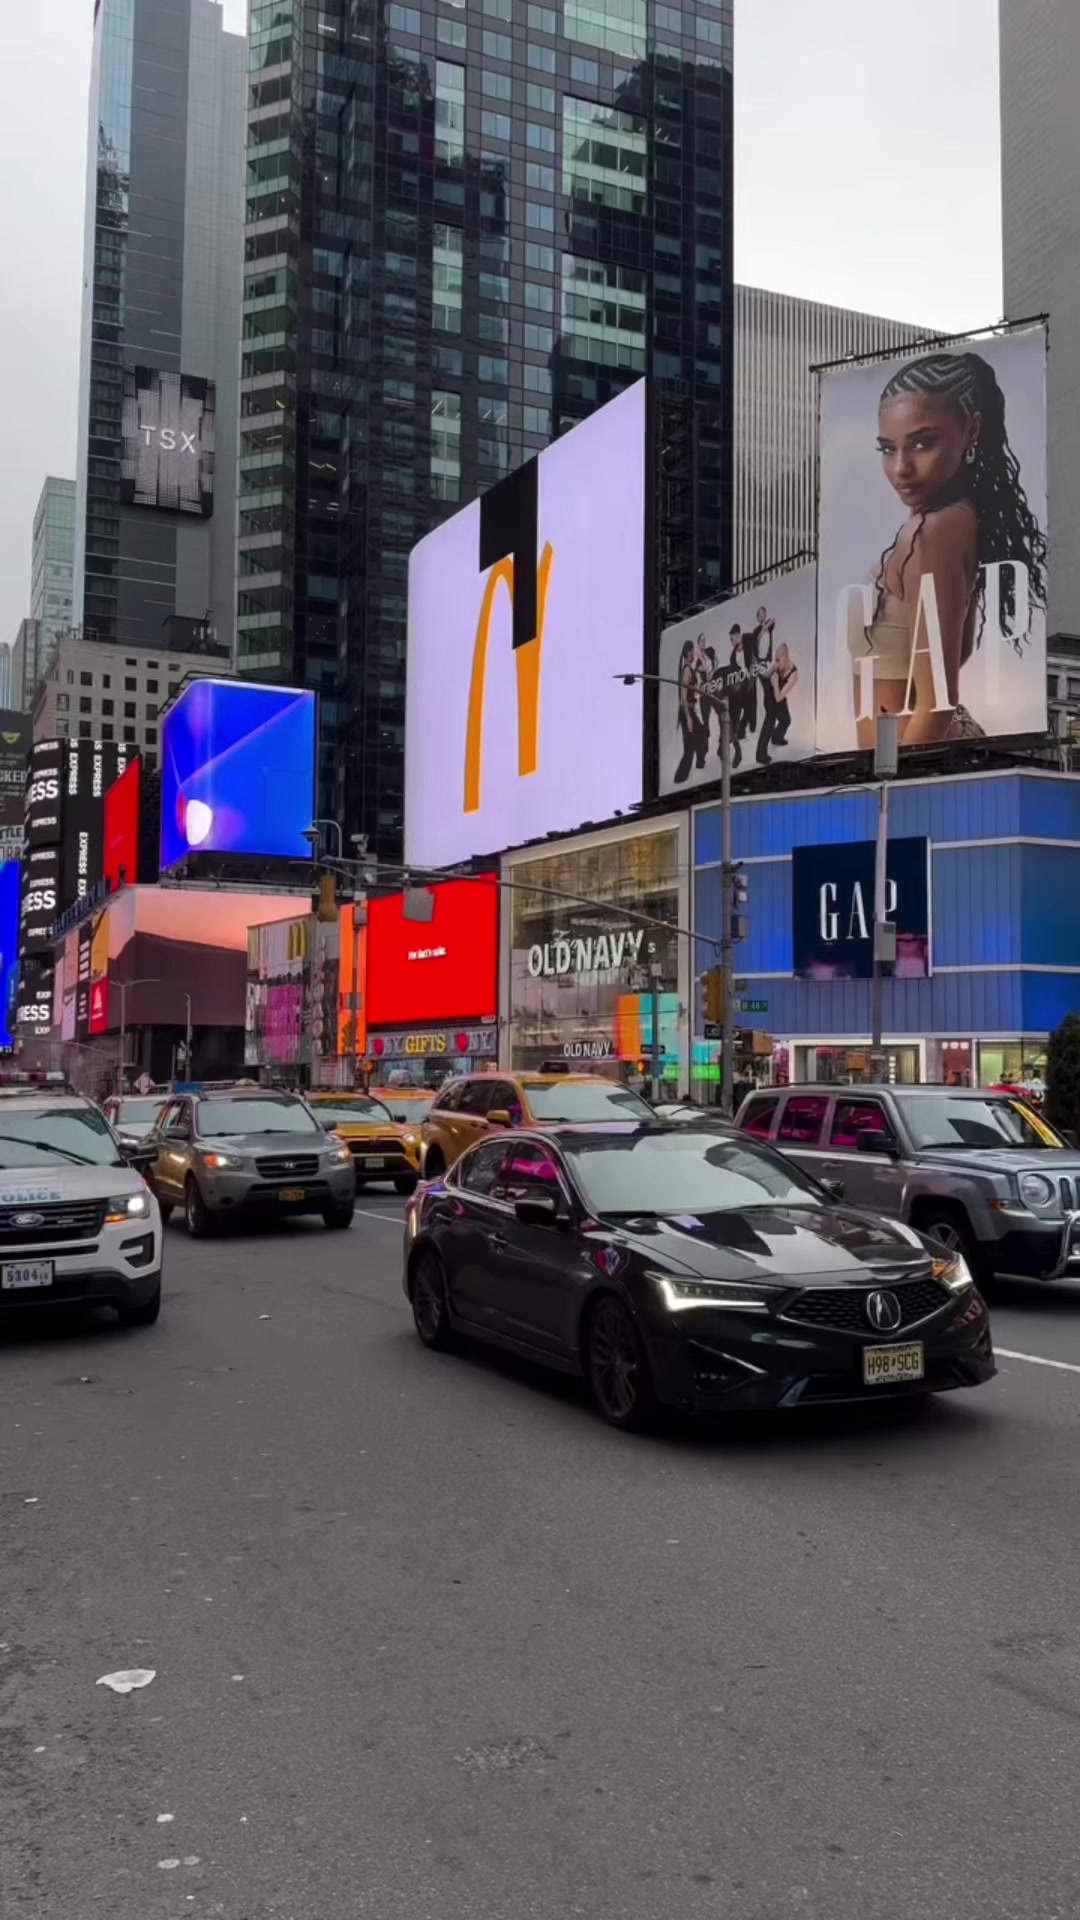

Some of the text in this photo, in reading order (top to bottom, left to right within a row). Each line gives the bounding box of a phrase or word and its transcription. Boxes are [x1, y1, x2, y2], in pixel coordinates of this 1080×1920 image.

[140, 425, 196, 454] TSX
[836, 560, 1029, 722] GAP
[68, 752, 79, 795] EXPRESS
[92, 754, 102, 797] EXPRESS
[78, 832, 89, 874] EXPRESS
[528, 941, 571, 977] OLD
[576, 929, 644, 973] NAVY
[405, 1033, 447, 1054] GIFTS
[563, 1041, 611, 1057] OLD NAVY
